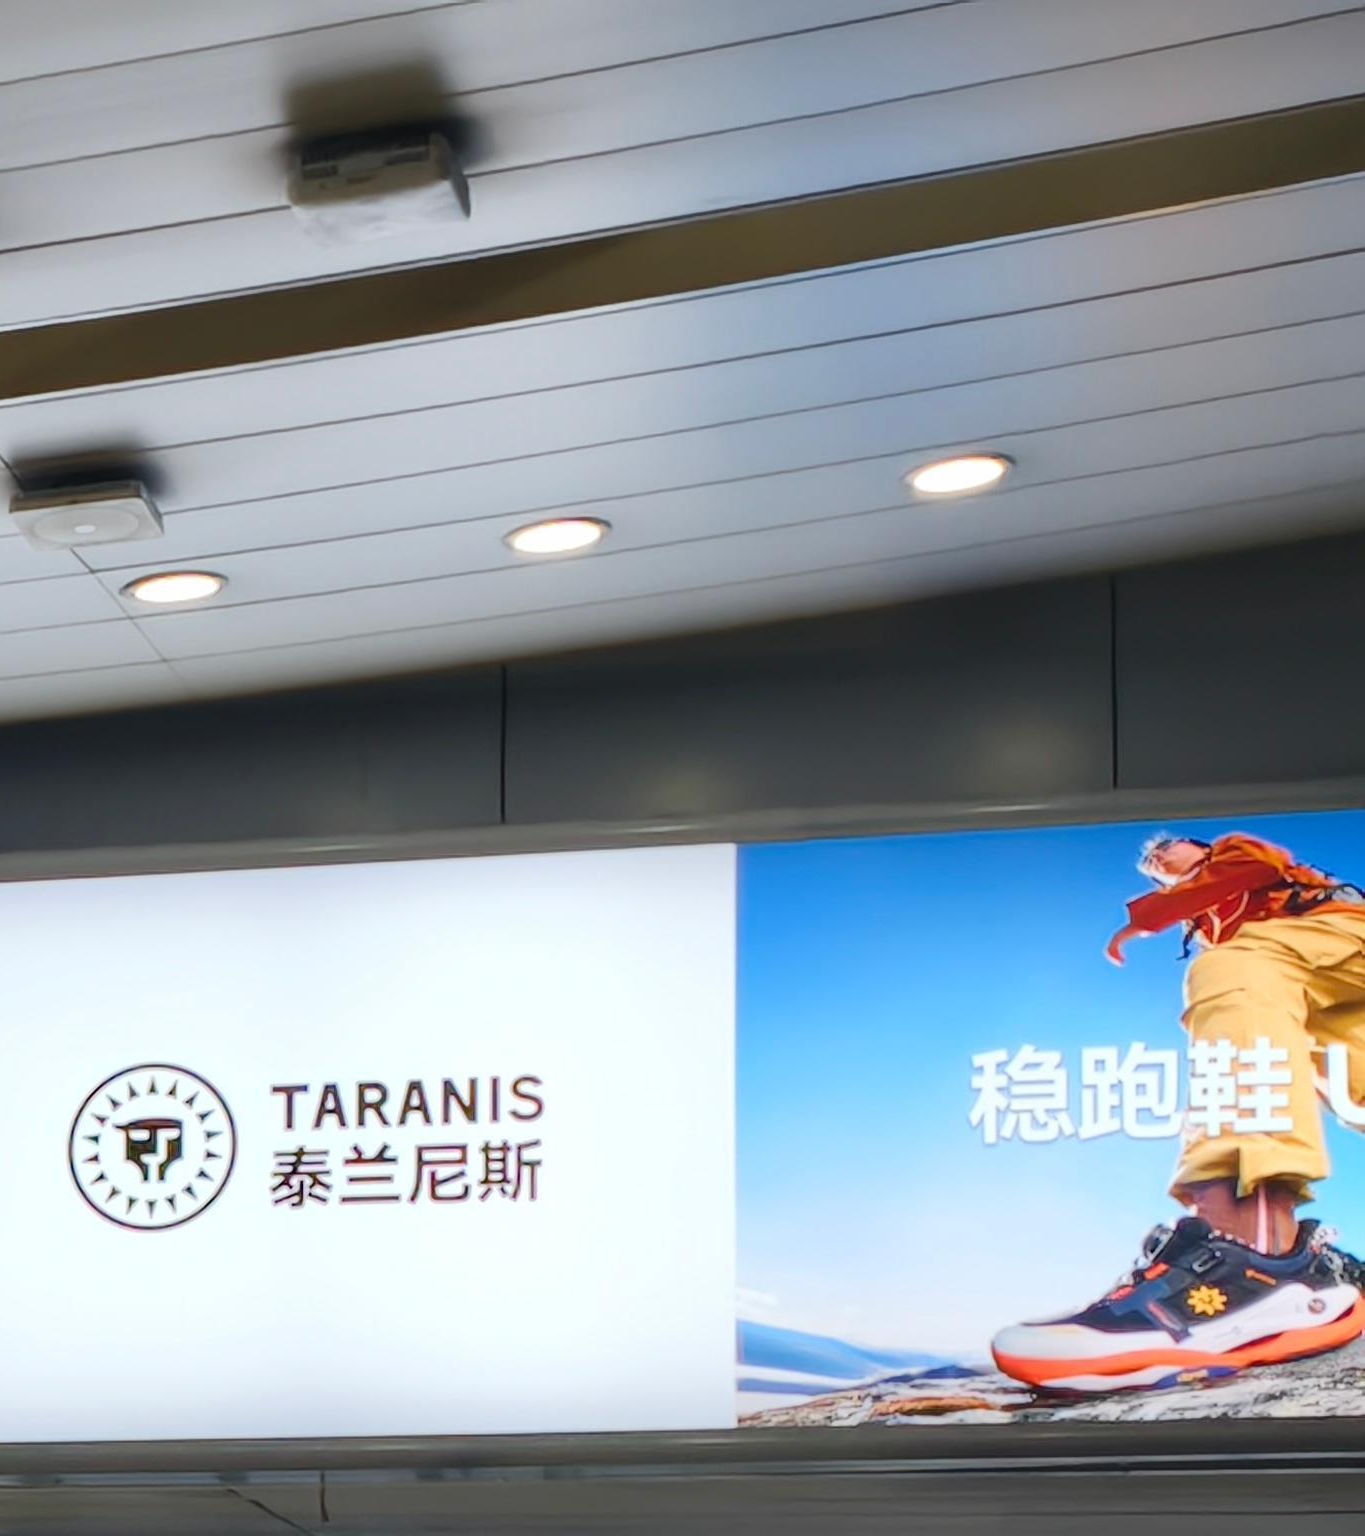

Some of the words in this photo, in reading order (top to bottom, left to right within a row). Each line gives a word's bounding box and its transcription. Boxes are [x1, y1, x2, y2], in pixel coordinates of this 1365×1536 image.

[271, 1074, 546, 1132] TARANIS
[969, 1037, 1293, 1145] 稳跑鞋
[270, 1139, 543, 1208] 泰兰尼斯
